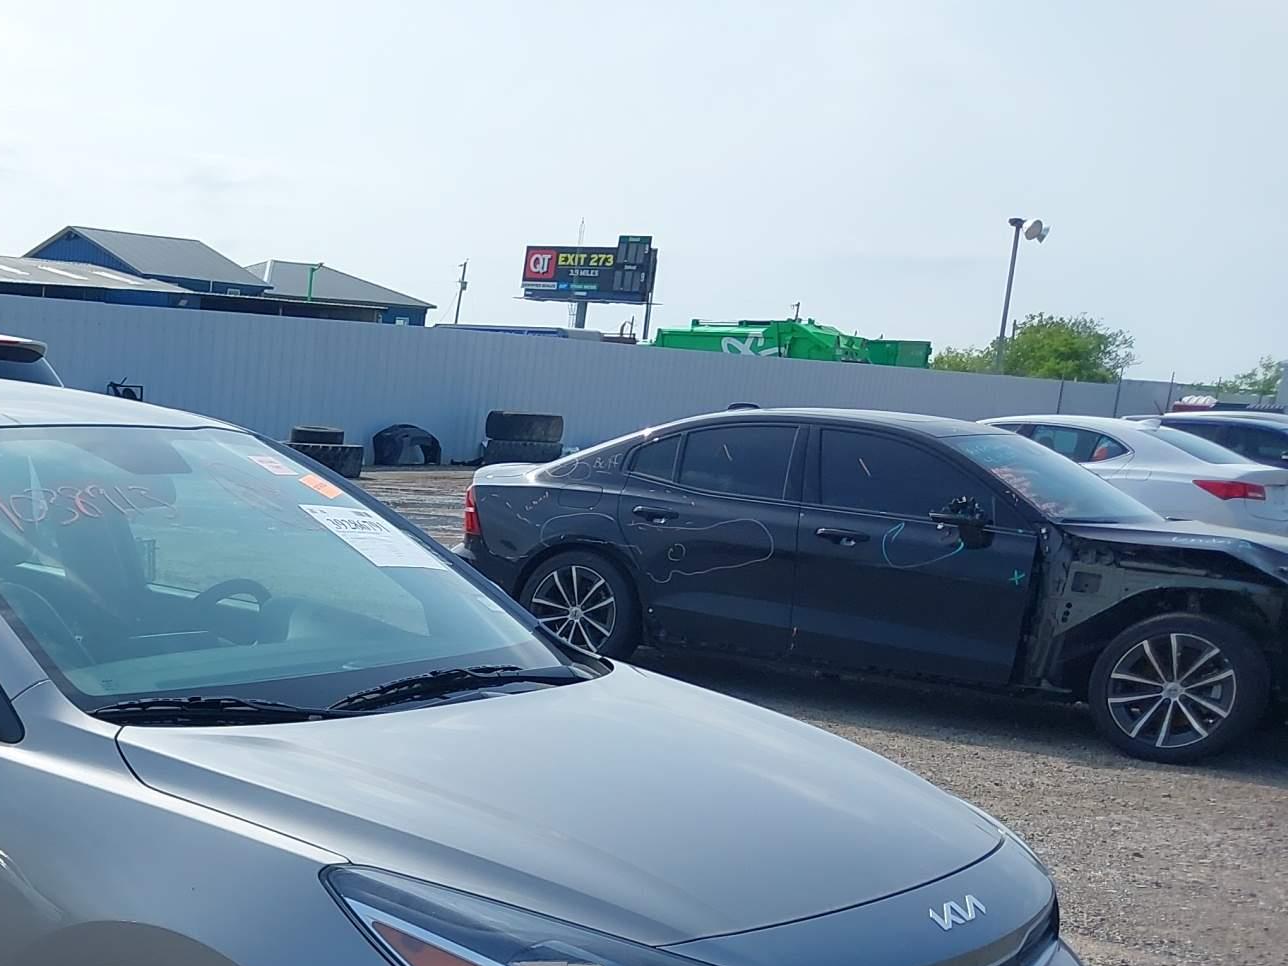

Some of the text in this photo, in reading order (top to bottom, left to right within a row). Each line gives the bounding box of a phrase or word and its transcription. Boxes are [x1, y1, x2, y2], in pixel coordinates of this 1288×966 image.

[529, 253, 553, 274] QT
[558, 253, 588, 267] EXIT
[589, 253, 614, 267] 273
[579, 269, 600, 278] MILES
[928, 894, 987, 931] KIA
